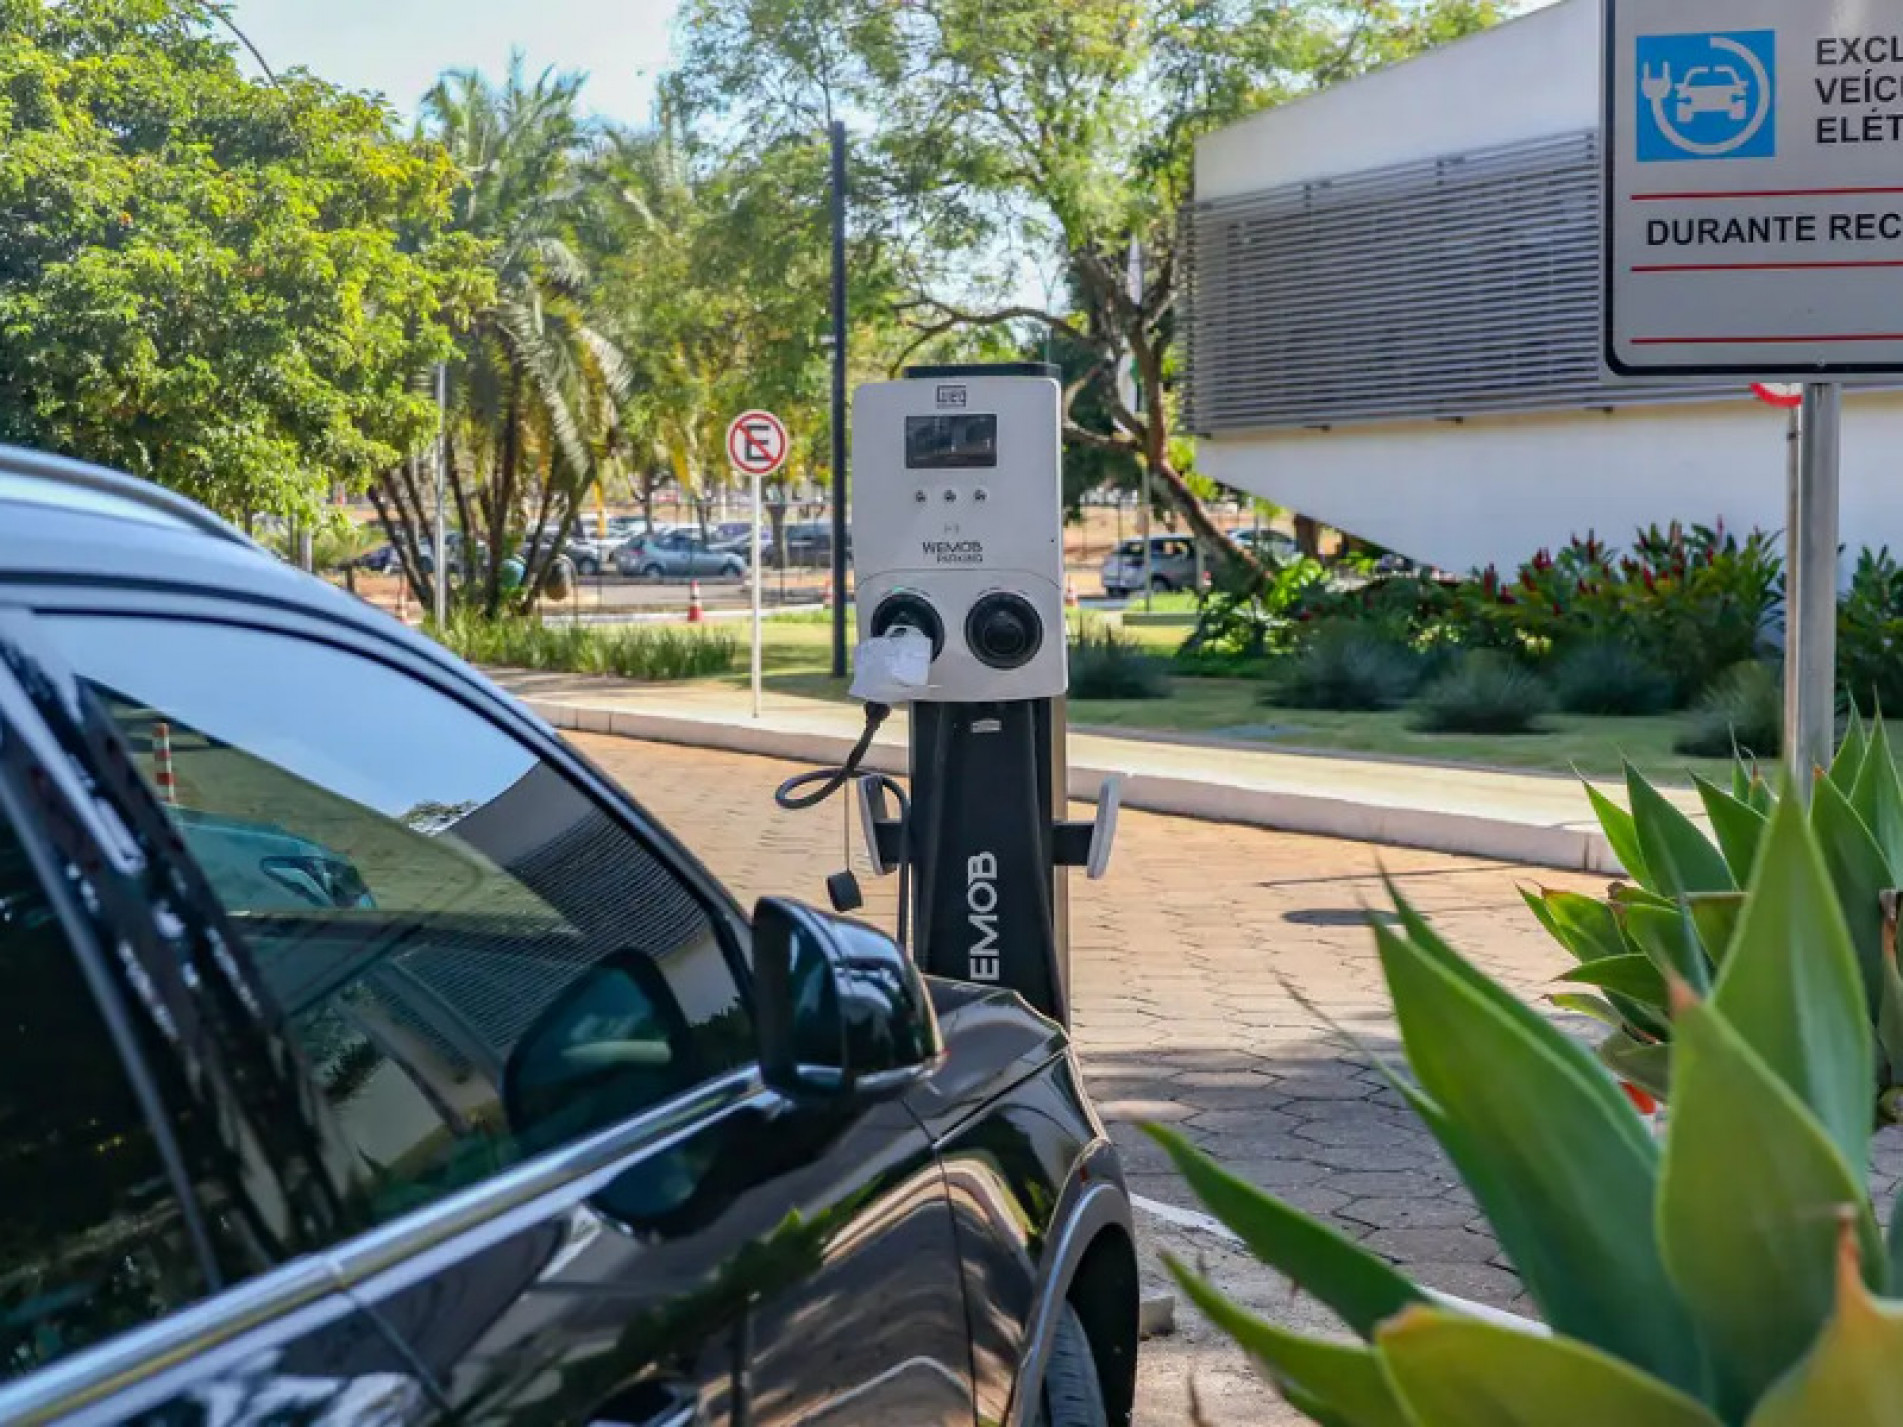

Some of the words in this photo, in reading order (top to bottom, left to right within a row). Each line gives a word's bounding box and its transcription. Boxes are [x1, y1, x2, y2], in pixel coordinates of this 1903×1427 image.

[1816, 36, 1903, 64] EXCL
[1814, 69, 1903, 105] VEÍC
[1816, 107, 1903, 143] ELÉT
[1646, 216, 1816, 245] DURANTE
[1829, 213, 1902, 240] REC
[745, 424, 773, 461] E
